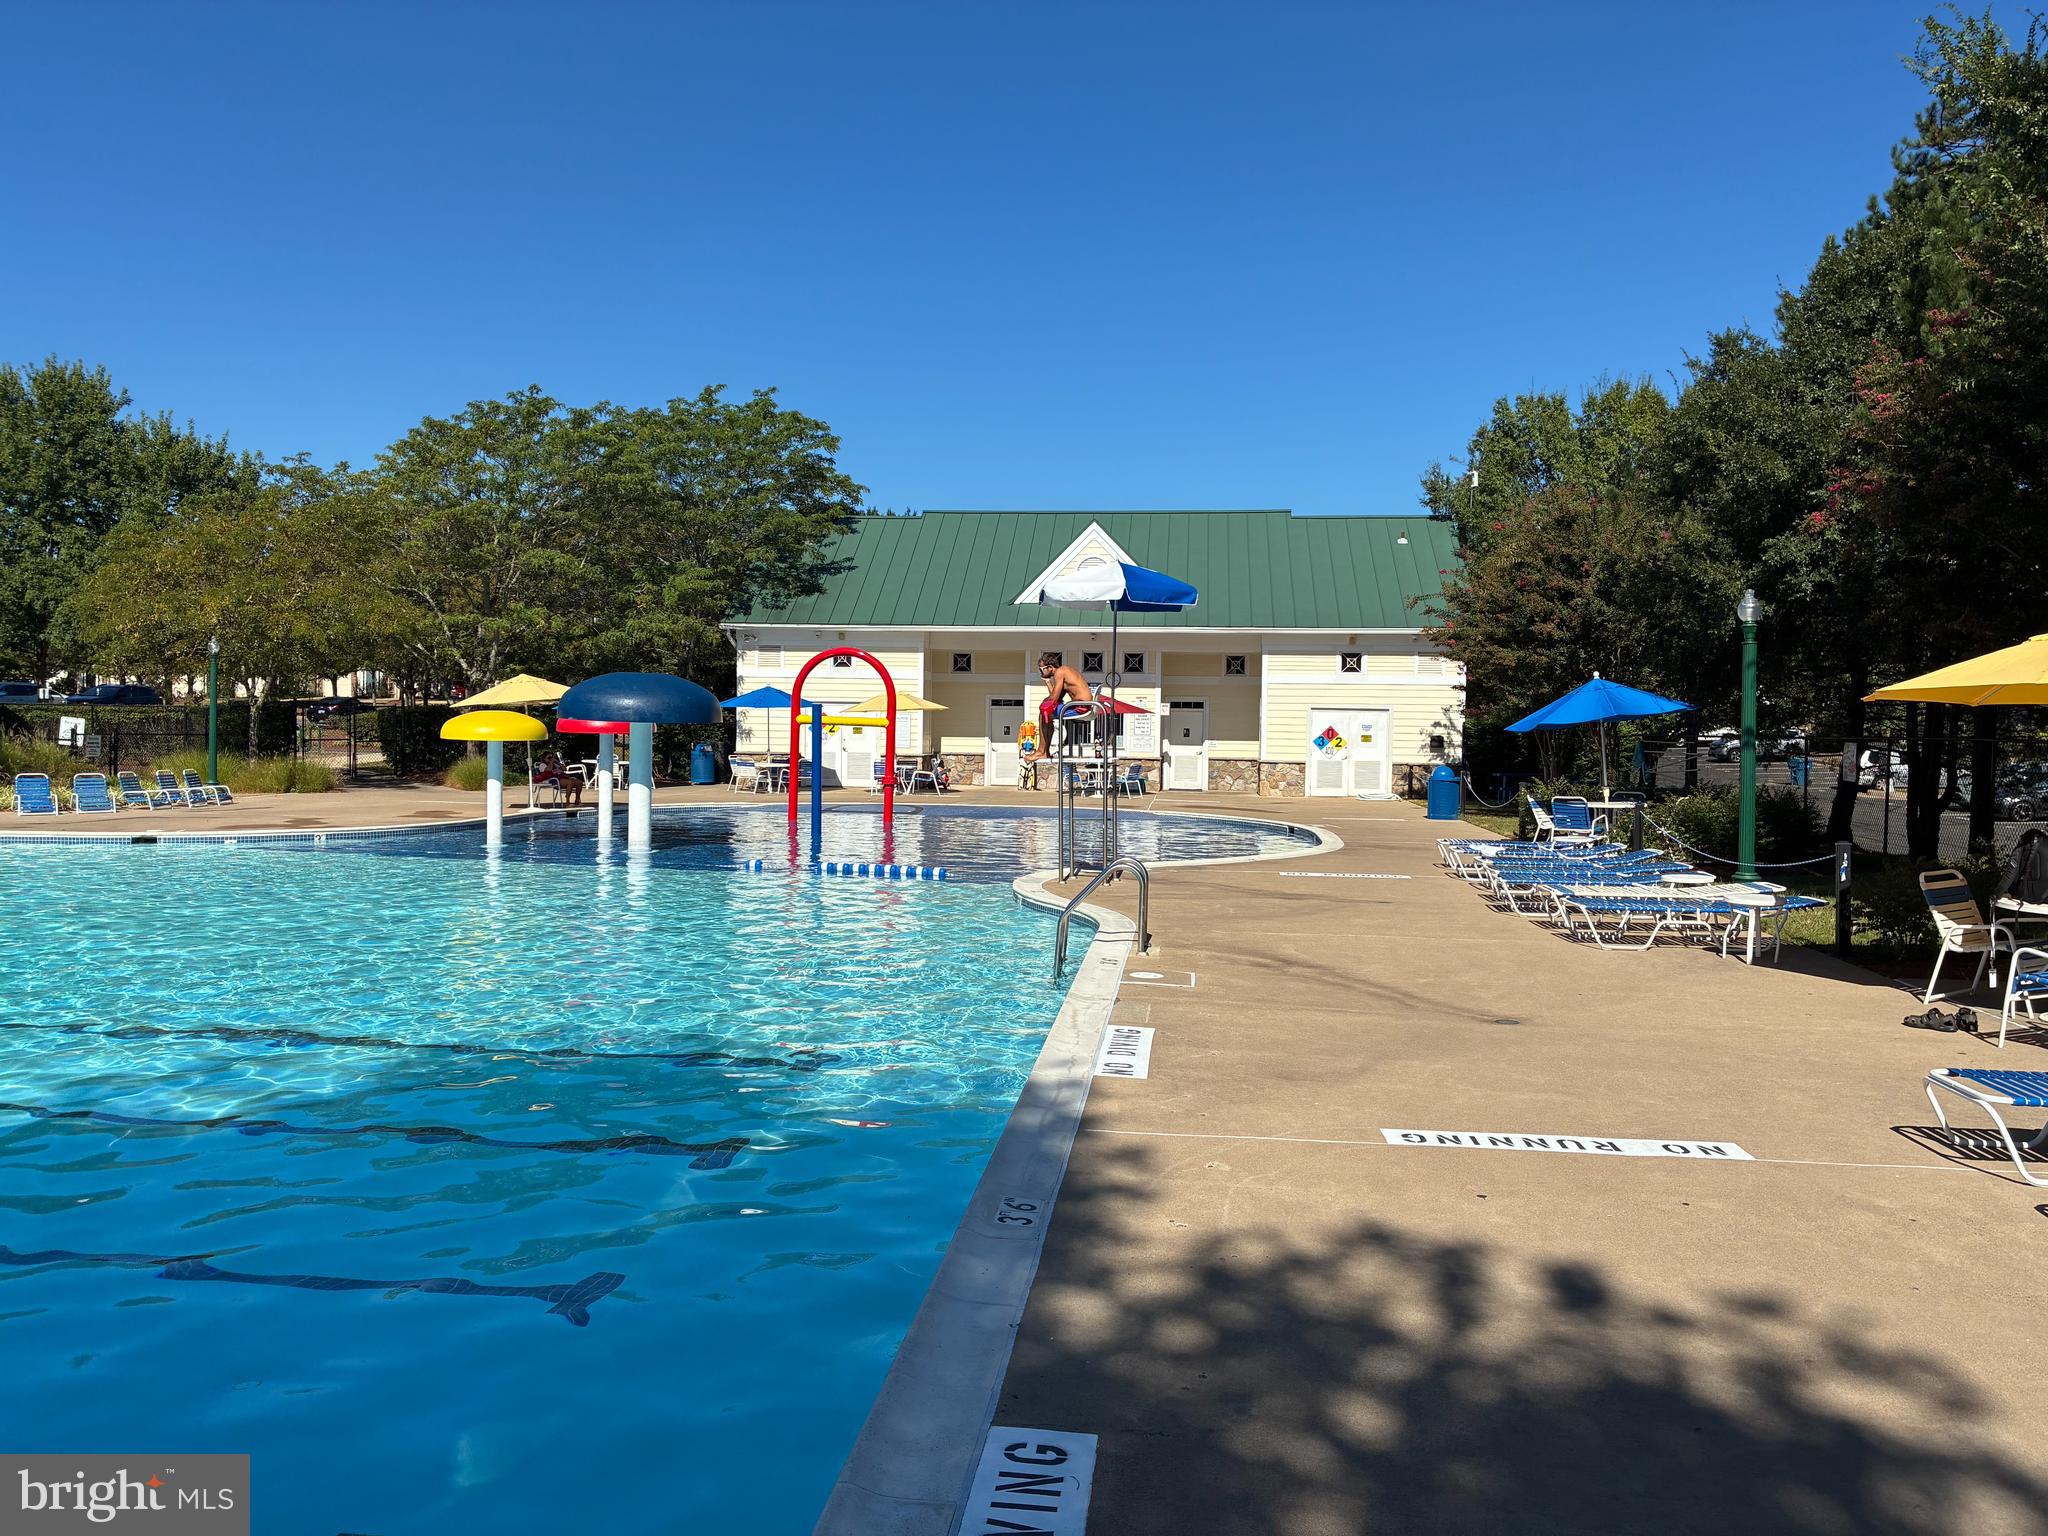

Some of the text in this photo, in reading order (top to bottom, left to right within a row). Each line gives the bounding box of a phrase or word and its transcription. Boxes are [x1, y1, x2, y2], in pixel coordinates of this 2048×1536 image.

[1327, 728, 1334, 739] 0
[1317, 736, 1325, 747] 3
[1335, 737, 1342, 747] 2
[1101, 1028, 1141, 1076] NO DIVING
[1400, 1132, 1731, 1157] NO RUNNING
